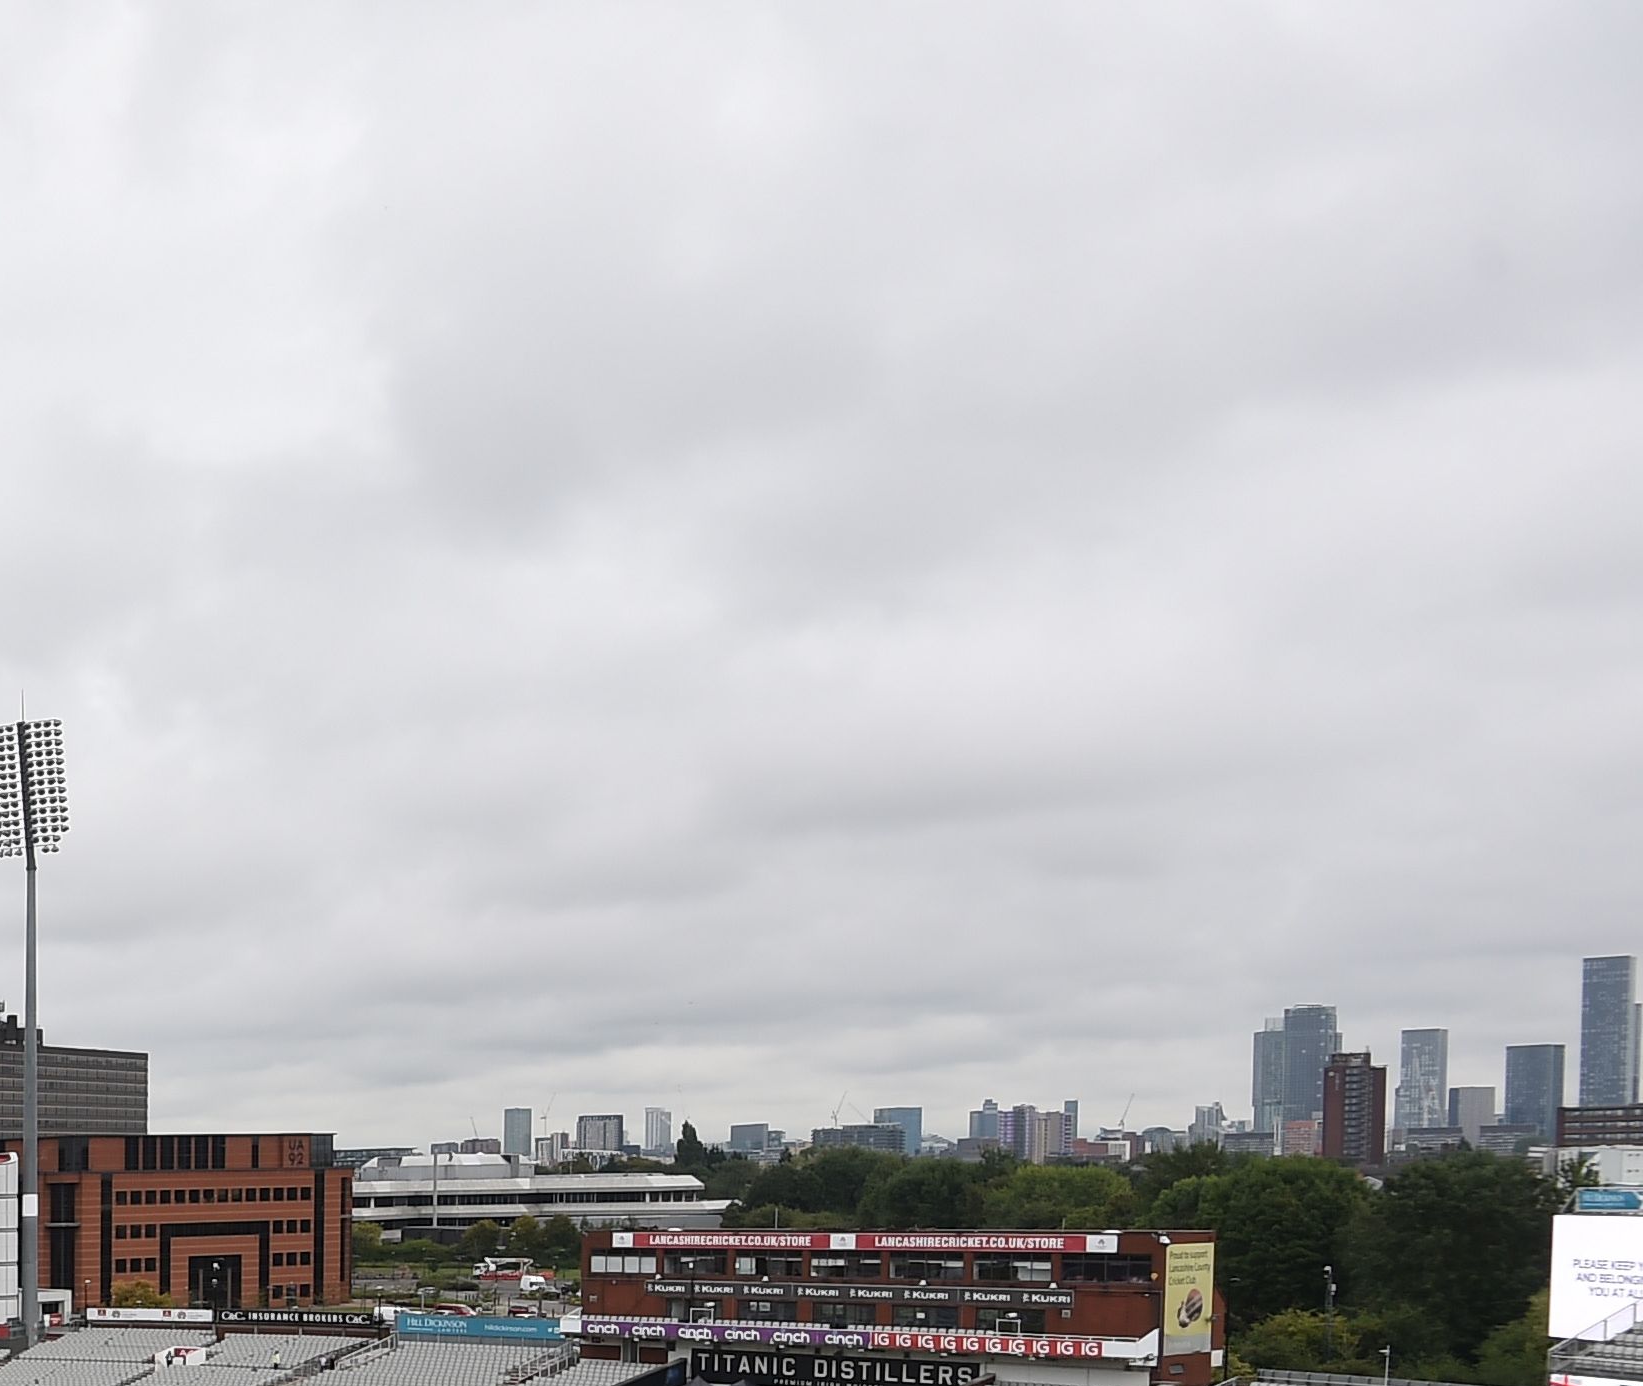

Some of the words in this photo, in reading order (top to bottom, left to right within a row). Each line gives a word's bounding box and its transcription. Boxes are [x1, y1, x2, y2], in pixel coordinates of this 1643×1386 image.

[288, 1153, 303, 1165] 92
[649, 1235, 811, 1247] LANCASHIRECRICKET.CO.UK/STORE
[875, 1236, 1064, 1249] LANCASHIRECRICKET.CO.UK/STORE
[1170, 1251, 1183, 1259] Proud
[1190, 1251, 1207, 1259] support
[1169, 1264, 1193, 1272] Lancashire
[1195, 1263, 1210, 1272] County
[1573, 1259, 1608, 1269] PLEASE
[1611, 1261, 1635, 1270] KEEP
[1169, 1277, 1184, 1285] Cricket
[1186, 1276, 1196, 1284] Club
[1576, 1273, 1597, 1283] AND
[655, 1284, 685, 1292] KUKRI
[702, 1285, 733, 1293] KUKRI
[750, 1286, 783, 1295] KUKRI
[805, 1288, 839, 1296] KUKRI
[857, 1289, 892, 1298] KUKRI
[1589, 1287, 1609, 1297] YOU
[1612, 1288, 1625, 1297] AT
[912, 1291, 948, 1300] KUKRI
[973, 1292, 1010, 1301] KUKRI
[1031, 1294, 1070, 1303] KUKRI
[248, 1311, 299, 1322] INSURANCE
[302, 1313, 343, 1323] BROKERS
[424, 1318, 467, 1328] DICKINSON
[485, 1324, 537, 1333] hilldickinson.com
[587, 1323, 619, 1335] cinch
[632, 1325, 665, 1336] cinch
[678, 1326, 712, 1341] cinch
[725, 1328, 760, 1341] cinch
[773, 1330, 810, 1344] cinch
[825, 1331, 863, 1345] cinch
[874, 1333, 889, 1346] IG
[896, 1334, 911, 1347] IG
[918, 1335, 934, 1348] IG
[941, 1336, 956, 1349] IG
[963, 1337, 979, 1350] IG
[986, 1338, 1002, 1351] IG
[1009, 1339, 1025, 1352] IG
[1033, 1341, 1050, 1354] IG
[1057, 1342, 1073, 1355] IG
[1081, 1343, 1098, 1355] IG
[697, 1353, 796, 1376] TITANIC
[814, 1359, 973, 1386] DISTILLERS
